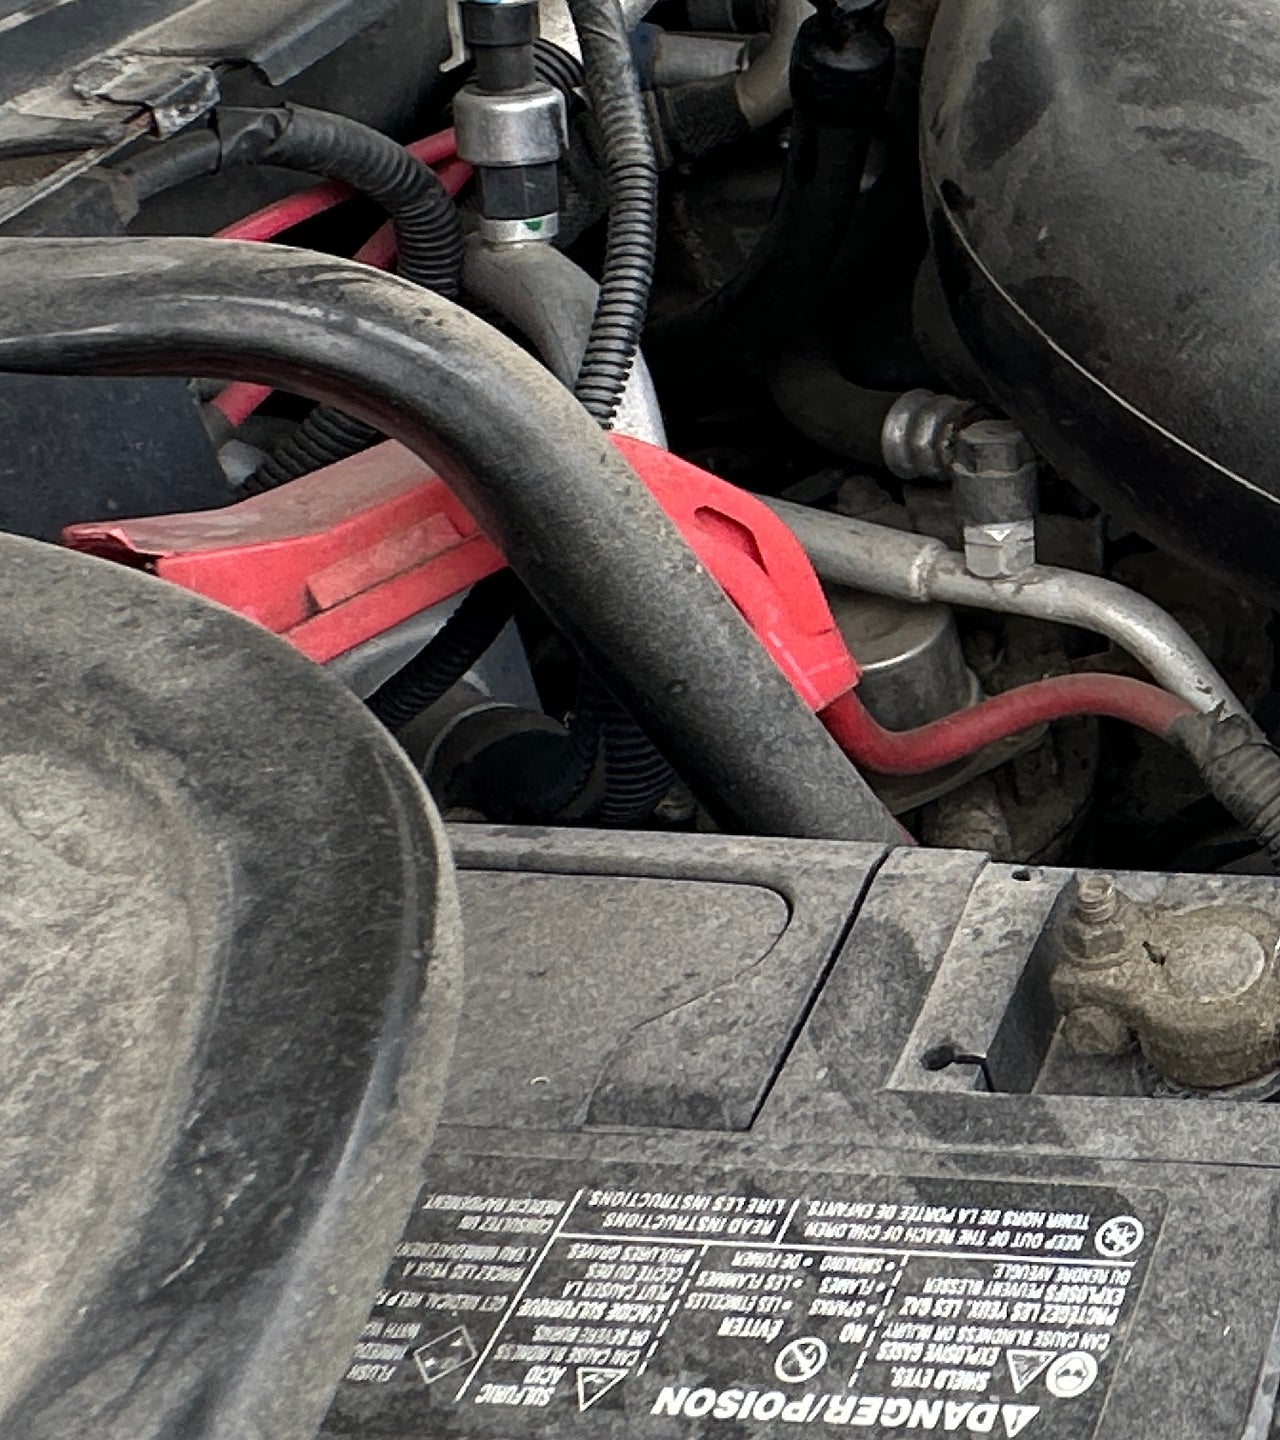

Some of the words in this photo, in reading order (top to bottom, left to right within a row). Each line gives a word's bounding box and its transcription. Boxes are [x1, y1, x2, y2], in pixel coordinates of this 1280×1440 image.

[714, 1196, 745, 1212] LES
[747, 1198, 787, 1213] LIRE
[876, 1204, 897, 1220] DE
[958, 1208, 979, 1224] LA
[980, 1210, 1001, 1226] DE
[1002, 1210, 1046, 1228] HORS
[1048, 1212, 1090, 1230] TENIR
[728, 1218, 777, 1235] READ
[880, 1226, 904, 1241] OF
[905, 1226, 956, 1244] REACH
[958, 1230, 986, 1246] THE
[988, 1230, 1010, 1246] OF
[1012, 1232, 1043, 1249] OUT
[1046, 1233, 1084, 1251] KEEP
[731, 1251, 782, 1267] FUMER
[782, 1253, 803, 1269] DE
[820, 1256, 885, 1273] SMOKING
[584, 1264, 615, 1279] DES
[615, 1264, 637, 1280] OU
[695, 1271, 765, 1288] FLAMMES
[1055, 1267, 1109, 1283] RENDRE
[1110, 1269, 1131, 1284] OU
[560, 1280, 581, 1296] LA
[582, 1281, 638, 1298] CAUSER
[766, 1274, 794, 1290] LES
[818, 1276, 876, 1295] FLAMES
[922, 1278, 984, 1296] BLESSER
[984, 1281, 1045, 1300] PEUVENT
[757, 1295, 783, 1311] LES
[1045, 1286, 1126, 1305] EXPLOSIFS
[514, 1297, 608, 1320] SULFURIQUE
[808, 1299, 866, 1315] SPARKS
[898, 1296, 934, 1316] GAZ
[935, 1300, 963, 1318] LES
[965, 1300, 1009, 1321] YEUX.
[1012, 1303, 1040, 1322] LES
[631, 1330, 650, 1345] OR
[838, 1323, 868, 1343] NO
[880, 1322, 934, 1340] INJURY
[935, 1327, 956, 1342] OR
[958, 1326, 1033, 1346] BLINDNESS
[1033, 1331, 1080, 1349] CAUSE
[1082, 1333, 1110, 1350] CAN
[564, 1346, 611, 1364] CAUSE
[611, 1348, 640, 1366] CAN
[875, 1340, 924, 1361] GASES
[924, 1343, 1000, 1364] EXPLOSIVE
[474, 1384, 556, 1406] SULFURIC
[522, 1366, 568, 1384] ACID
[890, 1366, 935, 1389] EYES.
[935, 1370, 990, 1392] SHIELD
[651, 1387, 1000, 1433] DANGER/POISON
